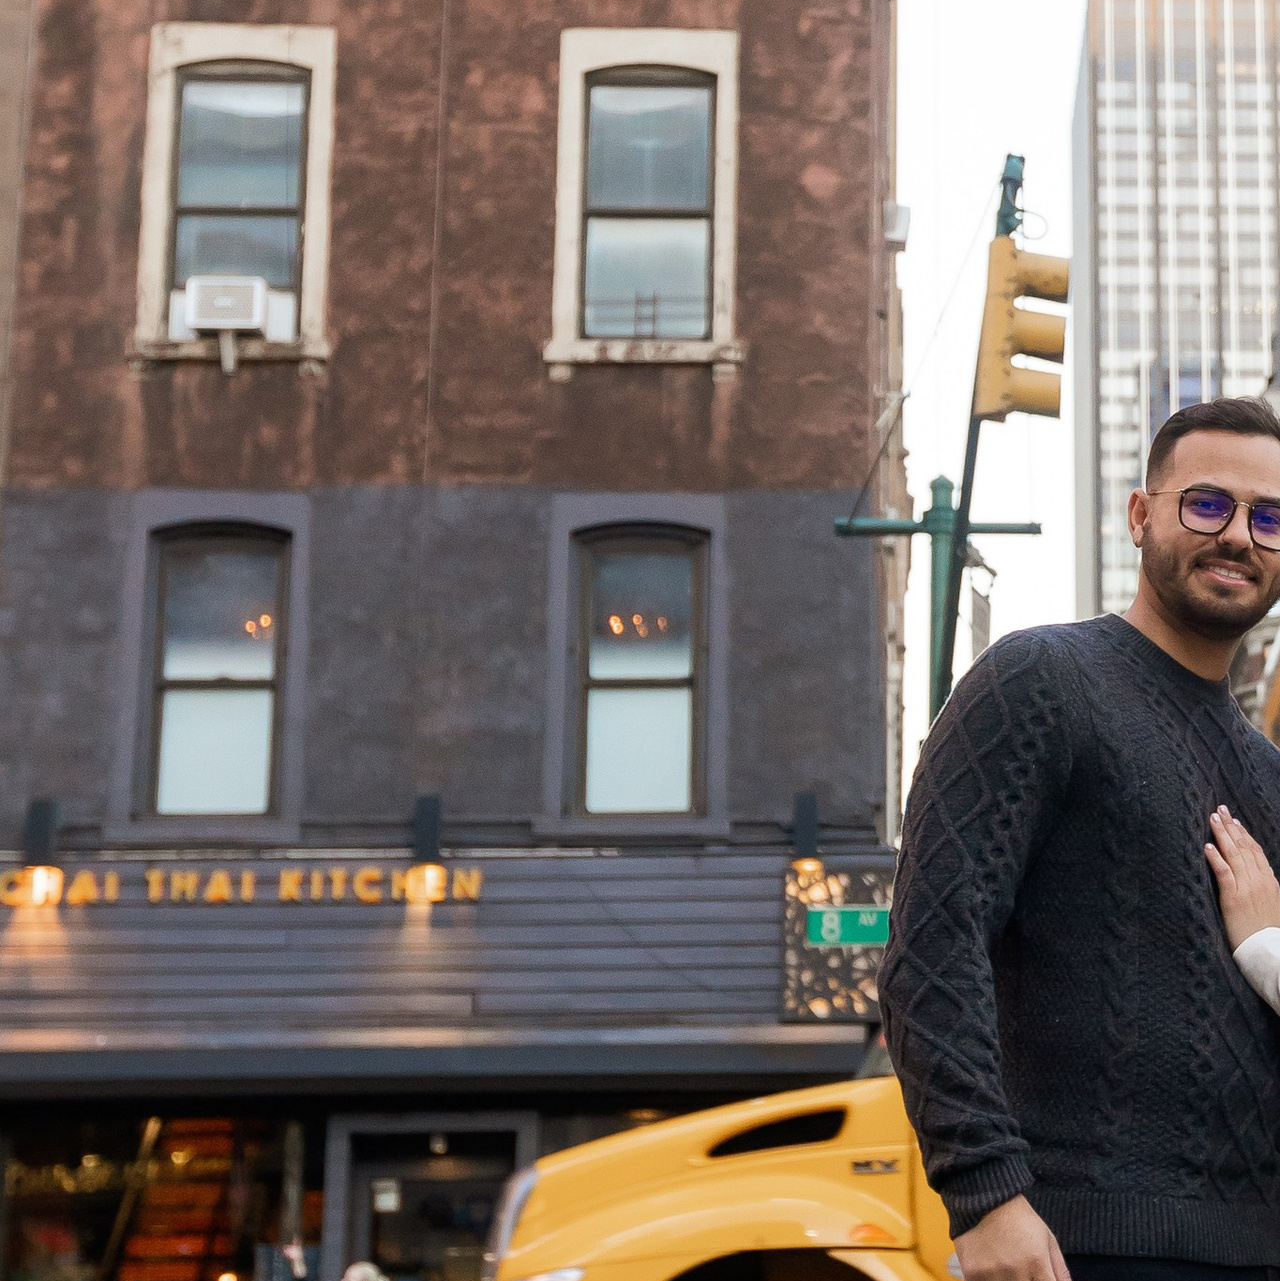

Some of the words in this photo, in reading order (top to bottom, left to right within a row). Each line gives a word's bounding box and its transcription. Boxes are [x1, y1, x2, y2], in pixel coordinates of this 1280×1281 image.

[146, 869, 255, 904] THAI
[278, 865, 483, 904] KITCHEN
[821, 910, 841, 943] 8
